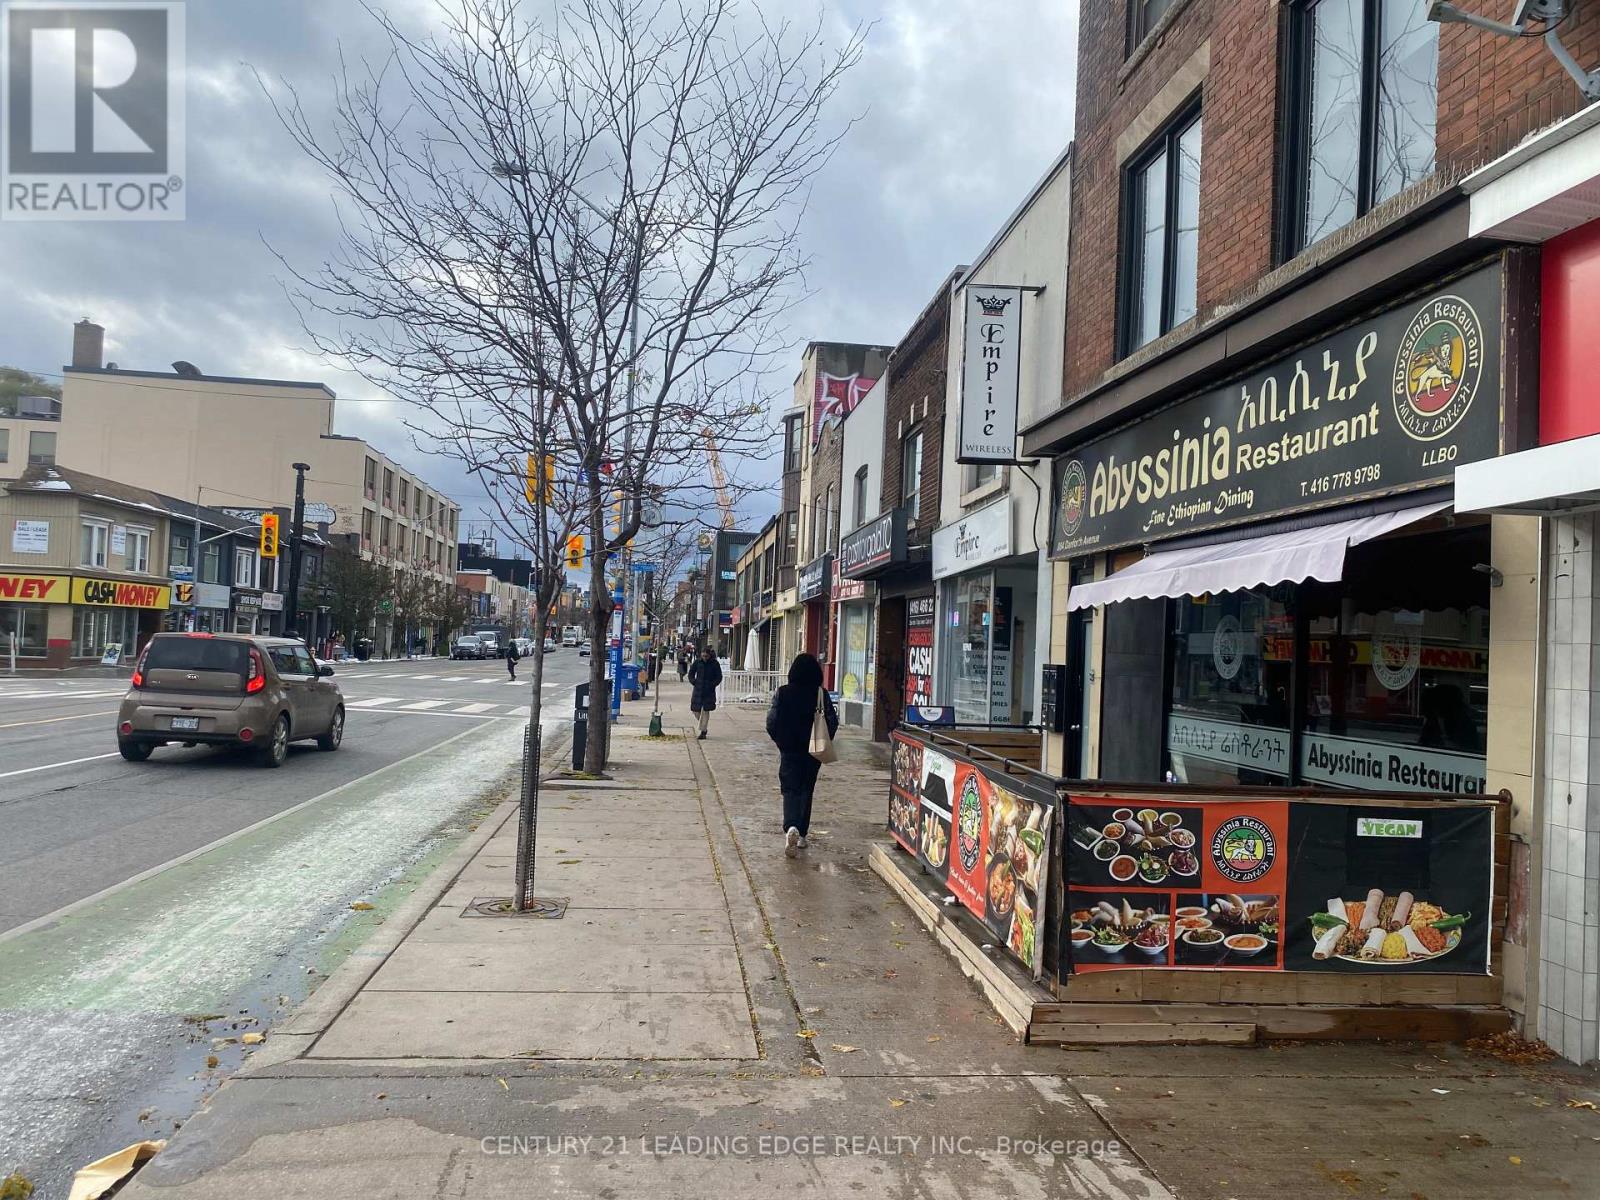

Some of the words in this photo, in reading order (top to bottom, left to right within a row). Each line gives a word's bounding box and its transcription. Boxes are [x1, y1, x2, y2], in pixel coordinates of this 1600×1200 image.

[1395, 312, 1431, 394] Abyssinia
[1434, 301, 1479, 369] Restaurant
[980, 323, 1006, 436] Empire
[965, 443, 1012, 454] WIRELESS
[1236, 401, 1380, 474] Restaurant
[1422, 444, 1458, 467] LLBO
[1089, 416, 1230, 518] Abyssinia
[1300, 481, 1308, 497] T.
[1311, 476, 1329, 495] 416
[1332, 471, 1351, 490] 778
[1354, 463, 1381, 485] 9798
[1142, 509, 1166, 532] Fine
[1166, 497, 1212, 527] Ethiopian
[1213, 486, 1254, 515] Dining
[909, 646, 933, 676] CASH
[1307, 742, 1383, 779] Abyssinia
[1212, 820, 1240, 856] Abyssinia
[1242, 818, 1274, 857] Restaurant
[1362, 821, 1417, 836] VEGAN
